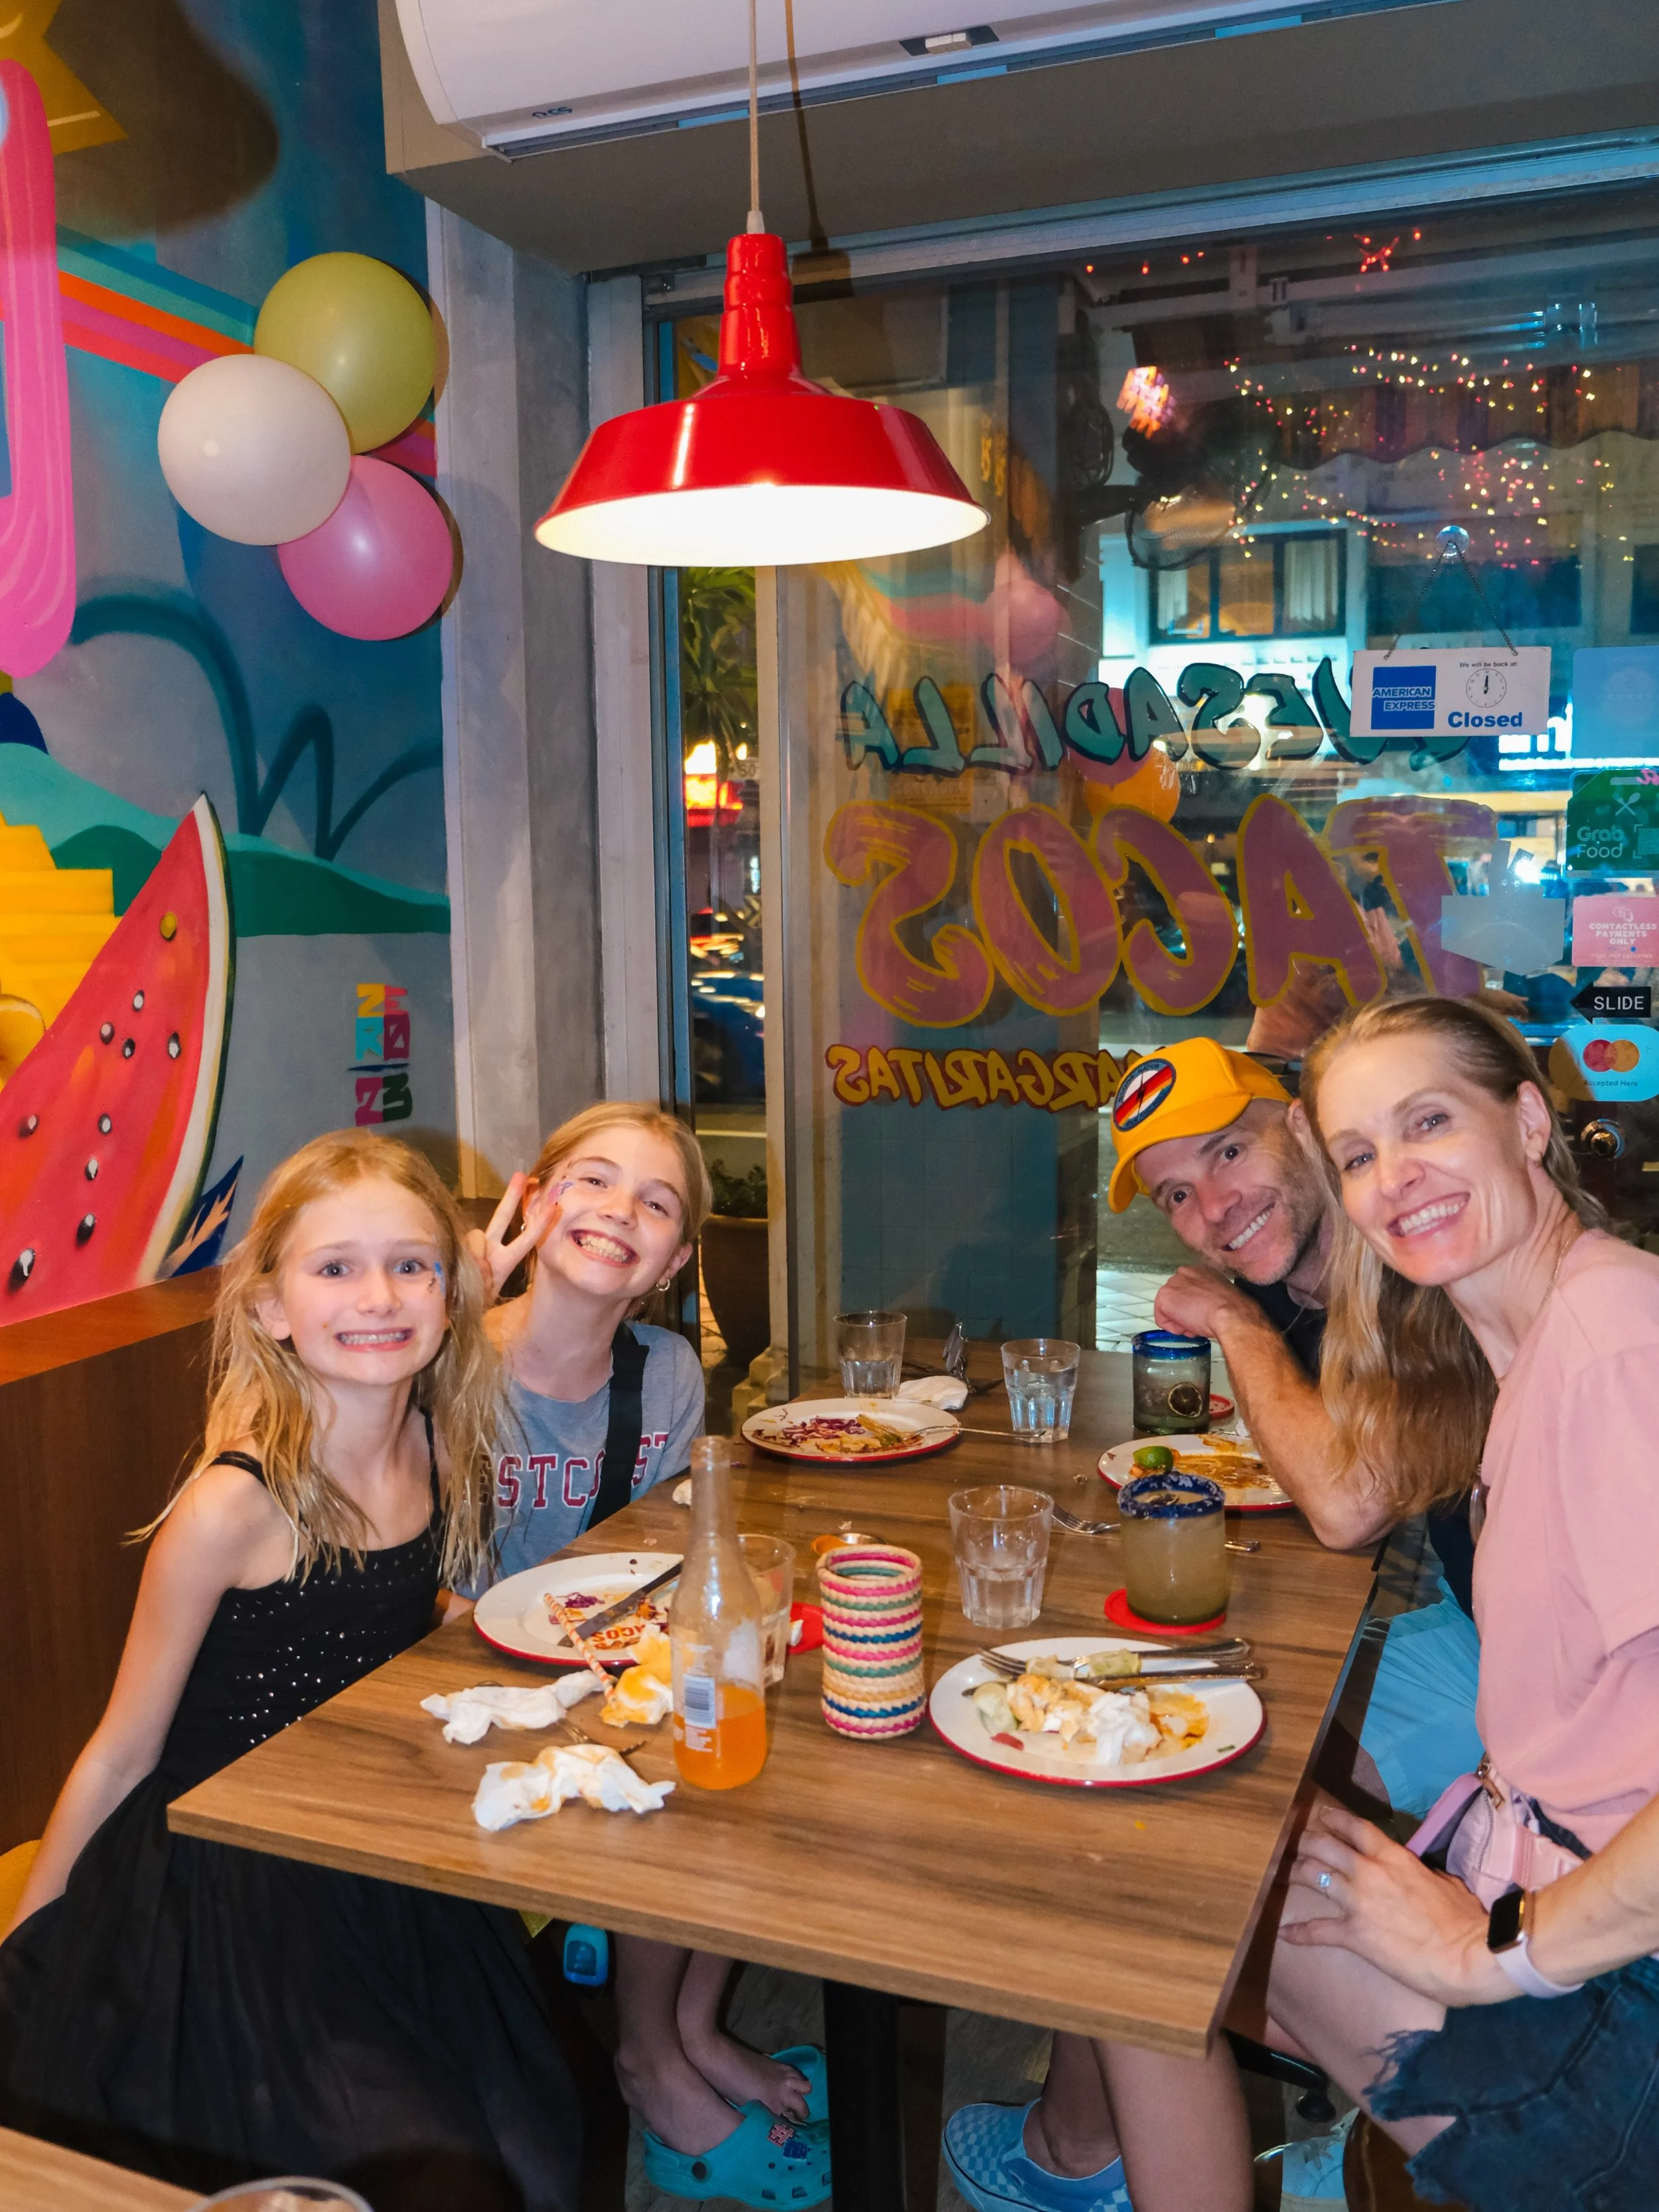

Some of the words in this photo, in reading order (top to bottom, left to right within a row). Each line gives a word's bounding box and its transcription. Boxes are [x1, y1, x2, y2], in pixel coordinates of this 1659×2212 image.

[1372, 687, 1431, 698] AMERICAN
[1384, 700, 1435, 711] EXPRESS
[1447, 711, 1523, 728] Closed
[1577, 825, 1624, 842] Grab
[1577, 843, 1623, 858] Food
[1594, 996, 1644, 1010] SLIDE
